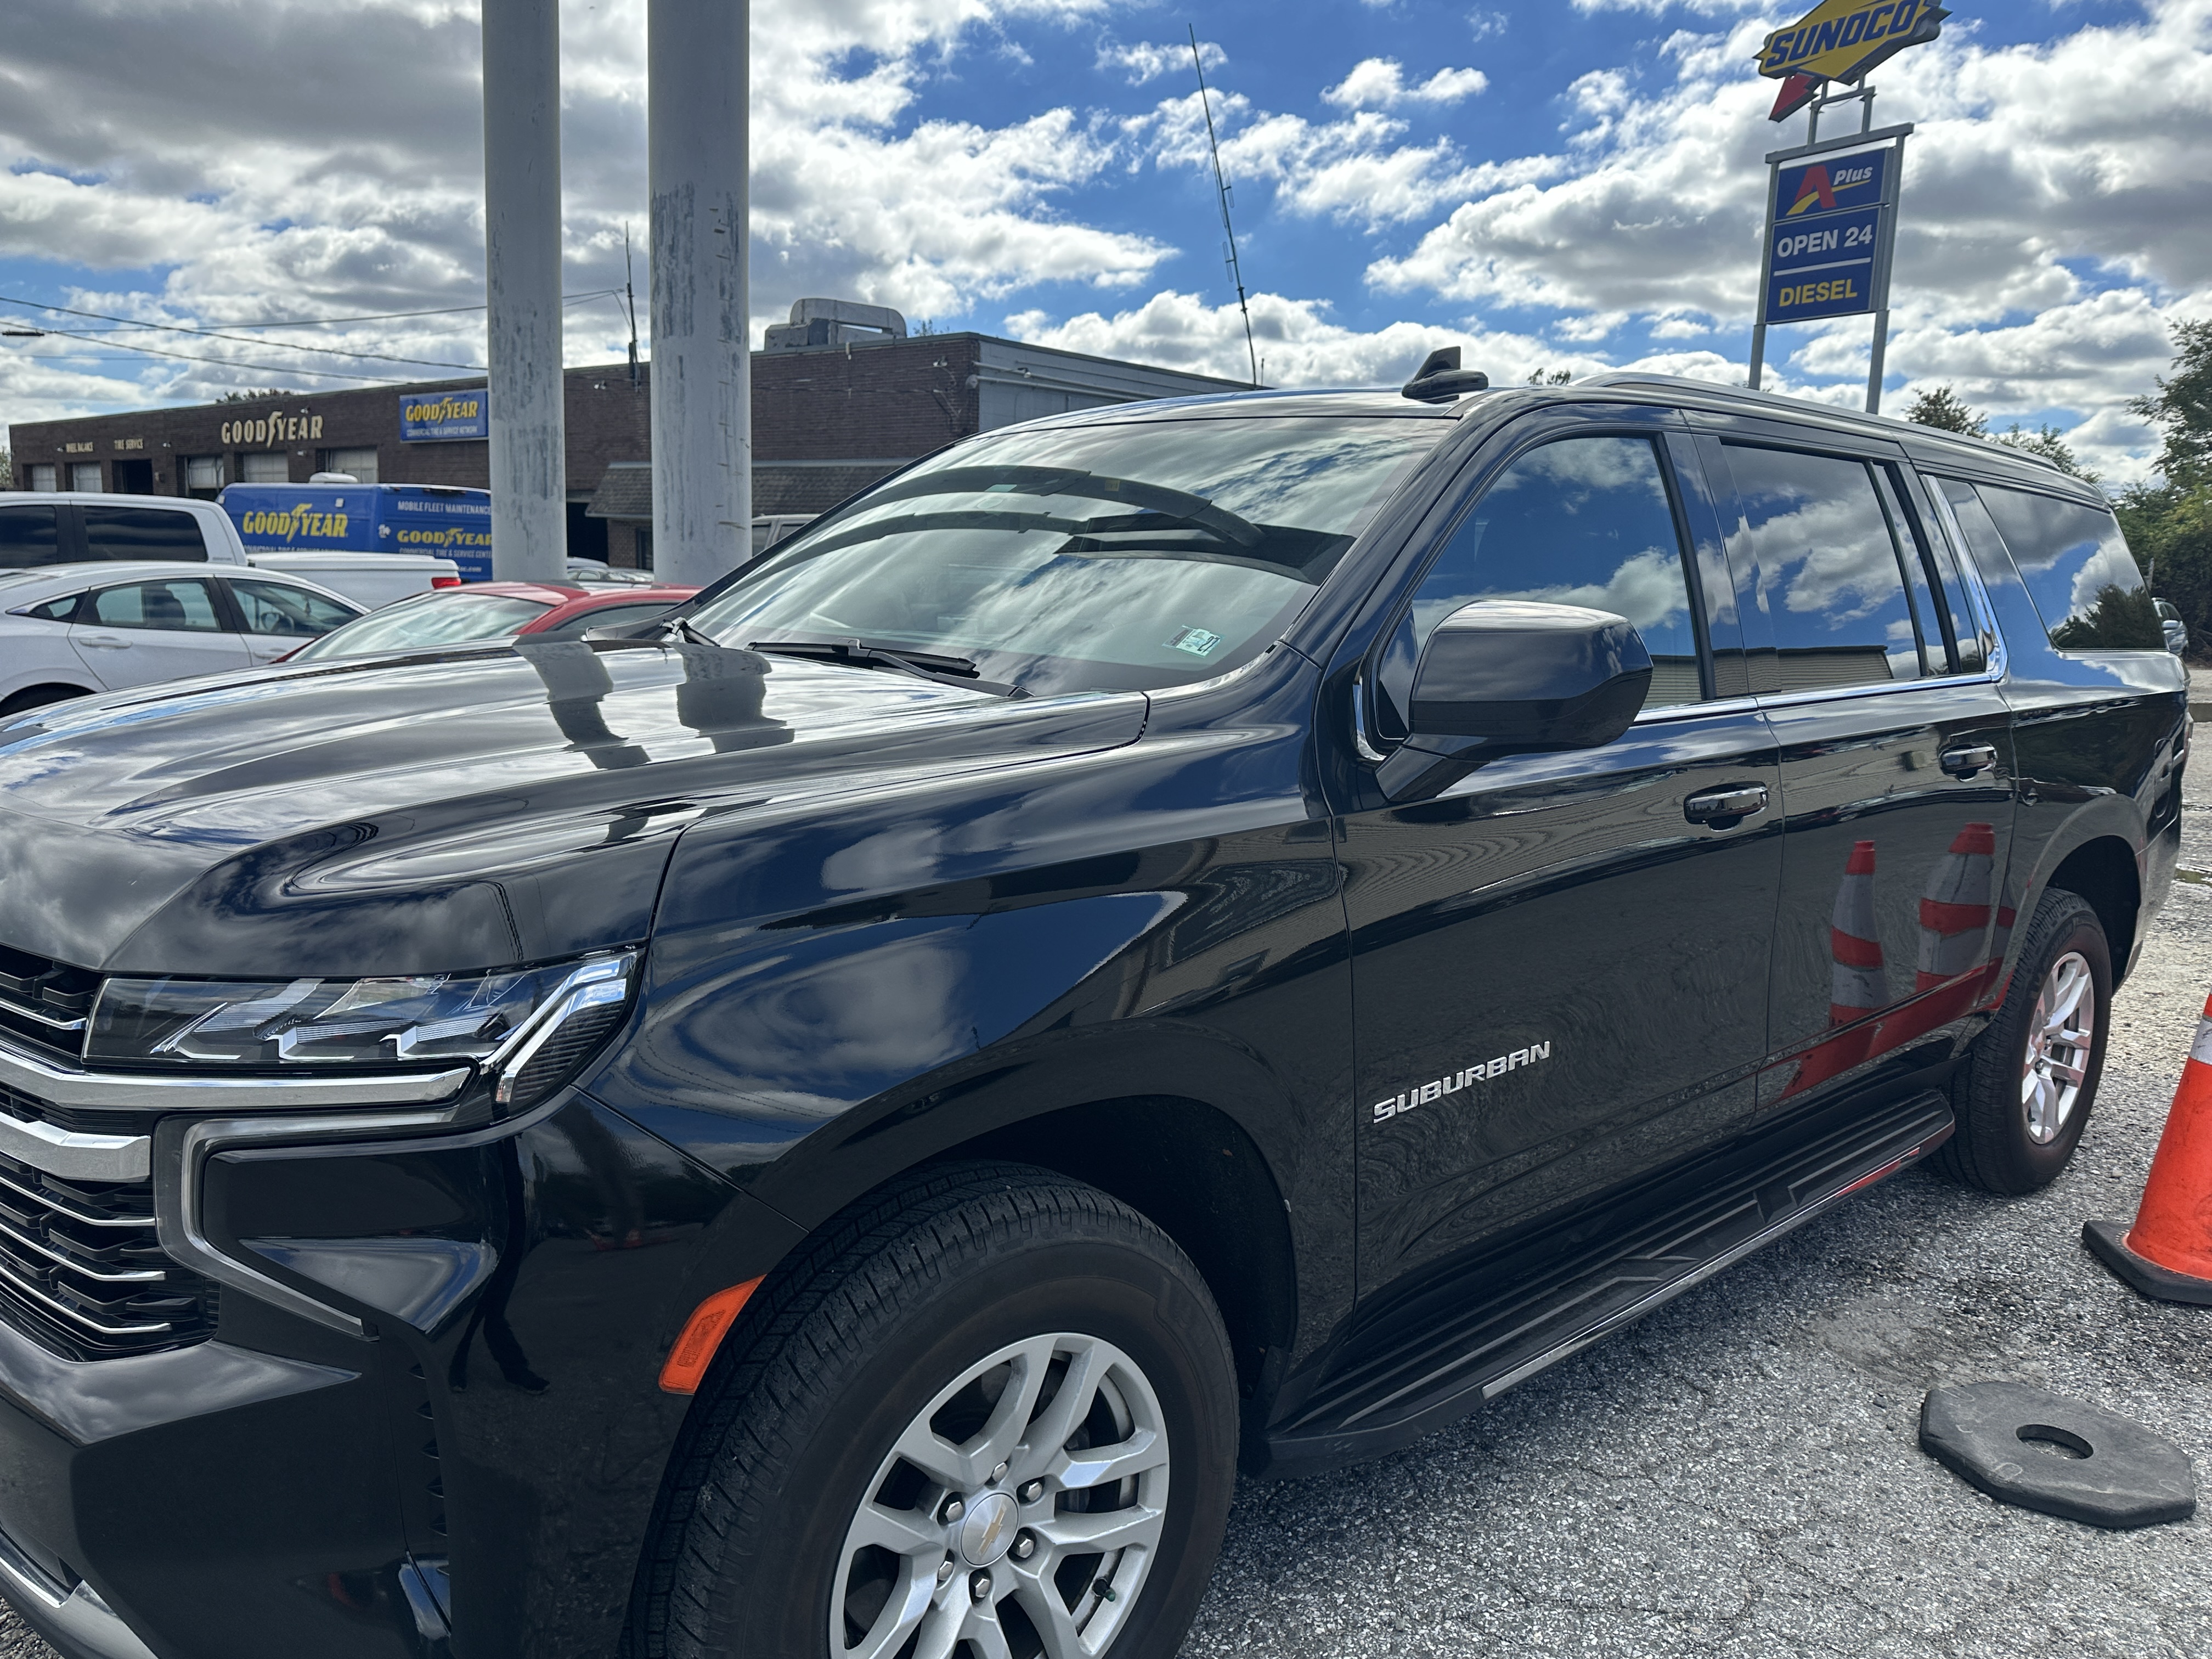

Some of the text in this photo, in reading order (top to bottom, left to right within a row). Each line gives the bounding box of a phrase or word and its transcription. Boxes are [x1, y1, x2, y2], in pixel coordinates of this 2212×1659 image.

[1765, 0, 1920, 67] SUNOCO
[1833, 166, 1873, 186] Plus
[1777, 224, 1872, 257] OPEN 24
[1779, 279, 1858, 307] DIESEL
[405, 397, 478, 425] GOODYEAR
[221, 411, 323, 448] GOODYEAR
[398, 500, 492, 515] MOBILE FLEET MAINTENANCE
[242, 503, 348, 543] GOODYEAR
[453, 549, 475, 558] SERVICE
[1373, 1041, 1550, 1124] SUBURBAN
